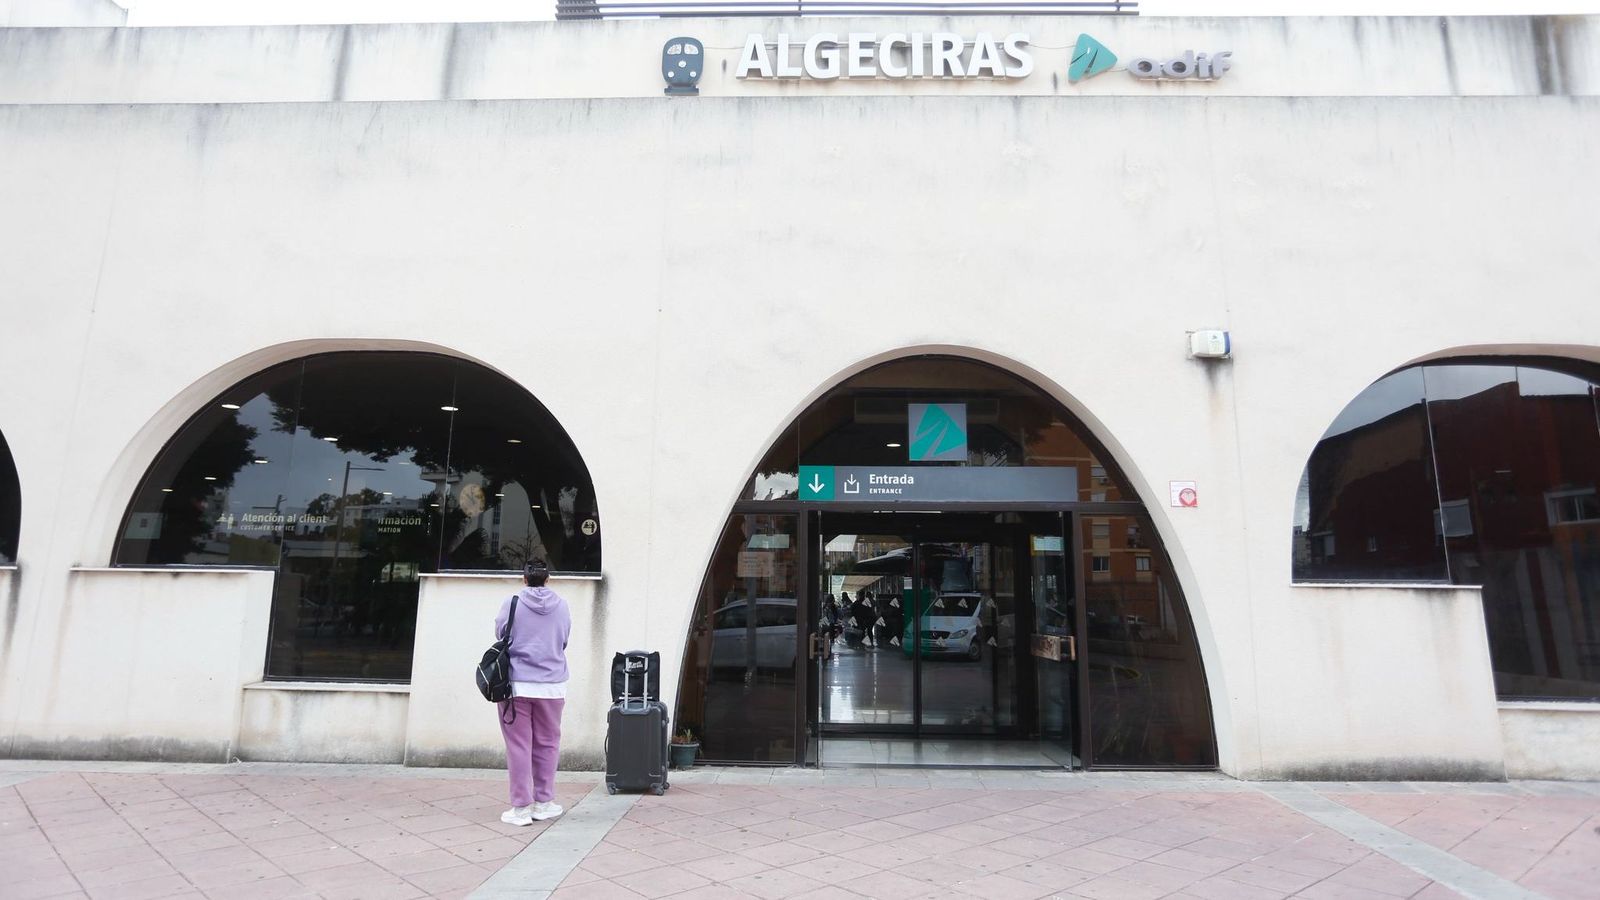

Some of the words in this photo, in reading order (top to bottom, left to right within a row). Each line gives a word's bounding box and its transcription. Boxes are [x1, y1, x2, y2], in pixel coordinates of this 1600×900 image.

[735, 32, 1034, 79] ALGECIRAS
[1128, 50, 1232, 78] adif
[869, 473, 914, 485] Entrada
[241, 512, 284, 523] Atención
[286, 514, 296, 523] al
